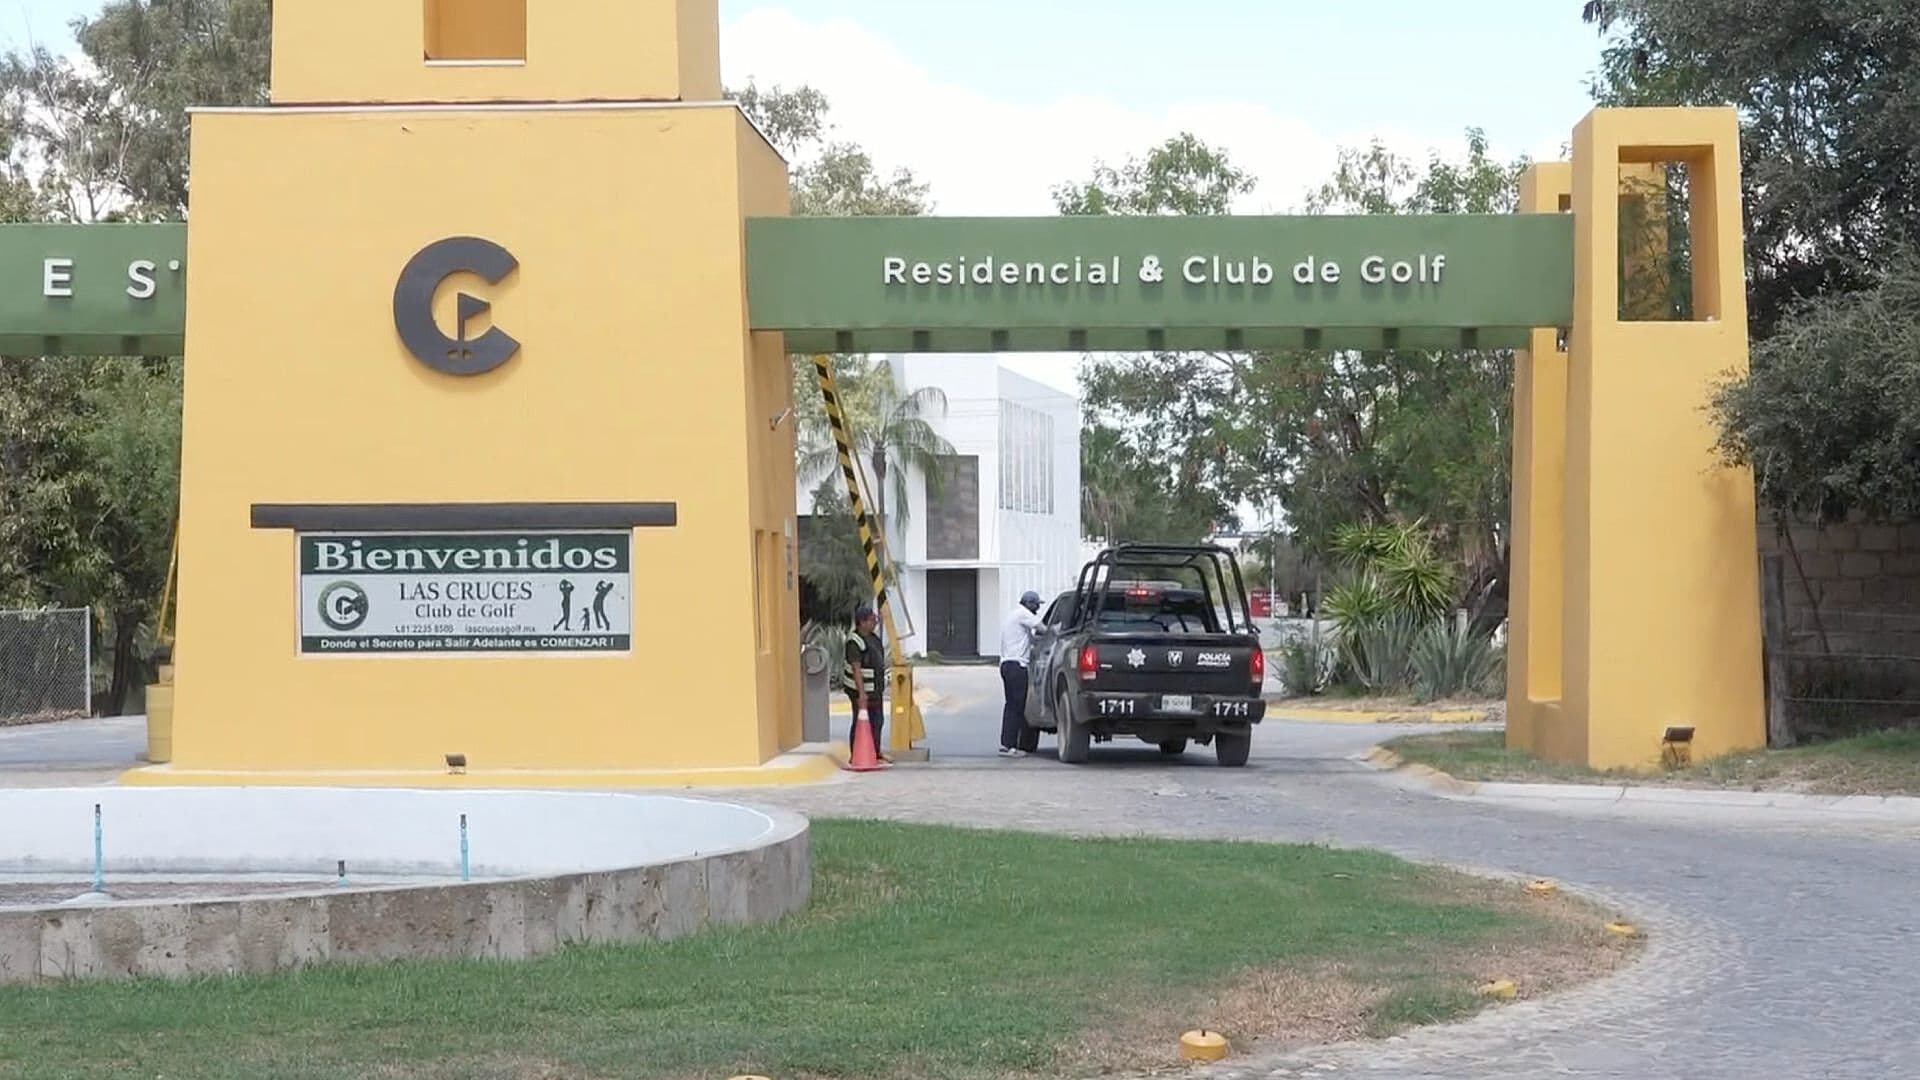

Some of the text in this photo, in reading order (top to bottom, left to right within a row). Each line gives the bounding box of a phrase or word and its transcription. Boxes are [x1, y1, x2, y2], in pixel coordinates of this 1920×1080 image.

[883, 254, 1446, 285] Residencial & Club de Golf
[314, 538, 617, 571] Bienvenidos
[400, 581, 533, 601] LAS CRUCES
[415, 603, 516, 618] Club de Golf
[320, 639, 357, 649] Donde
[359, 639, 370, 649] el
[372, 638, 415, 649] Secreto
[417, 639, 443, 650] para
[446, 638, 470, 648] Salir
[472, 637, 522, 648] Adelante
[524, 639, 537, 648] es
[540, 637, 608, 648] COMENZAR
[1098, 699, 1249, 716] 1711 1711
